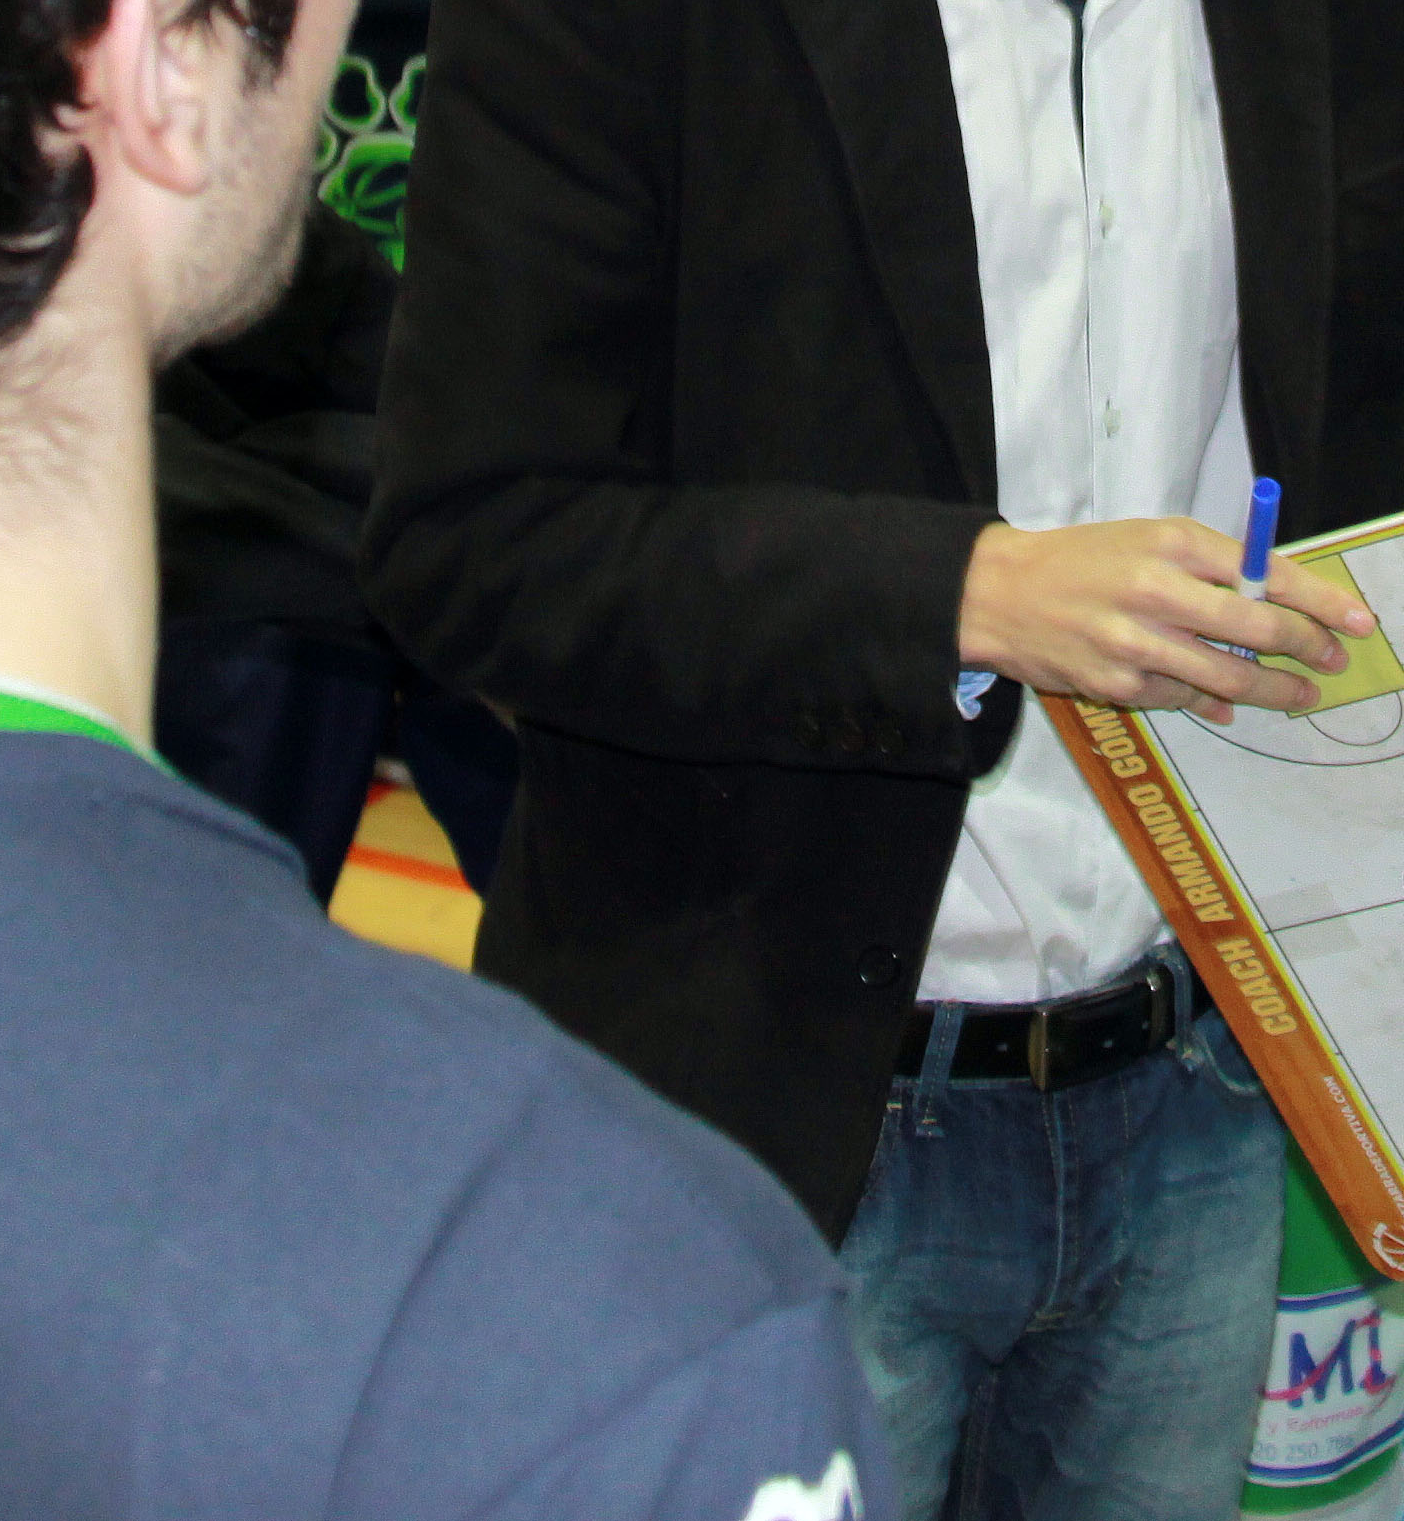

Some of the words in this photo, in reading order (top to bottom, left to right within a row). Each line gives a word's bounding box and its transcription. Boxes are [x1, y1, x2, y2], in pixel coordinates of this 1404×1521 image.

[1127, 783, 1236, 923] ARMANDO
[1217, 936, 1297, 1036] COACH
[1288, 1308, 1386, 1408] MI
